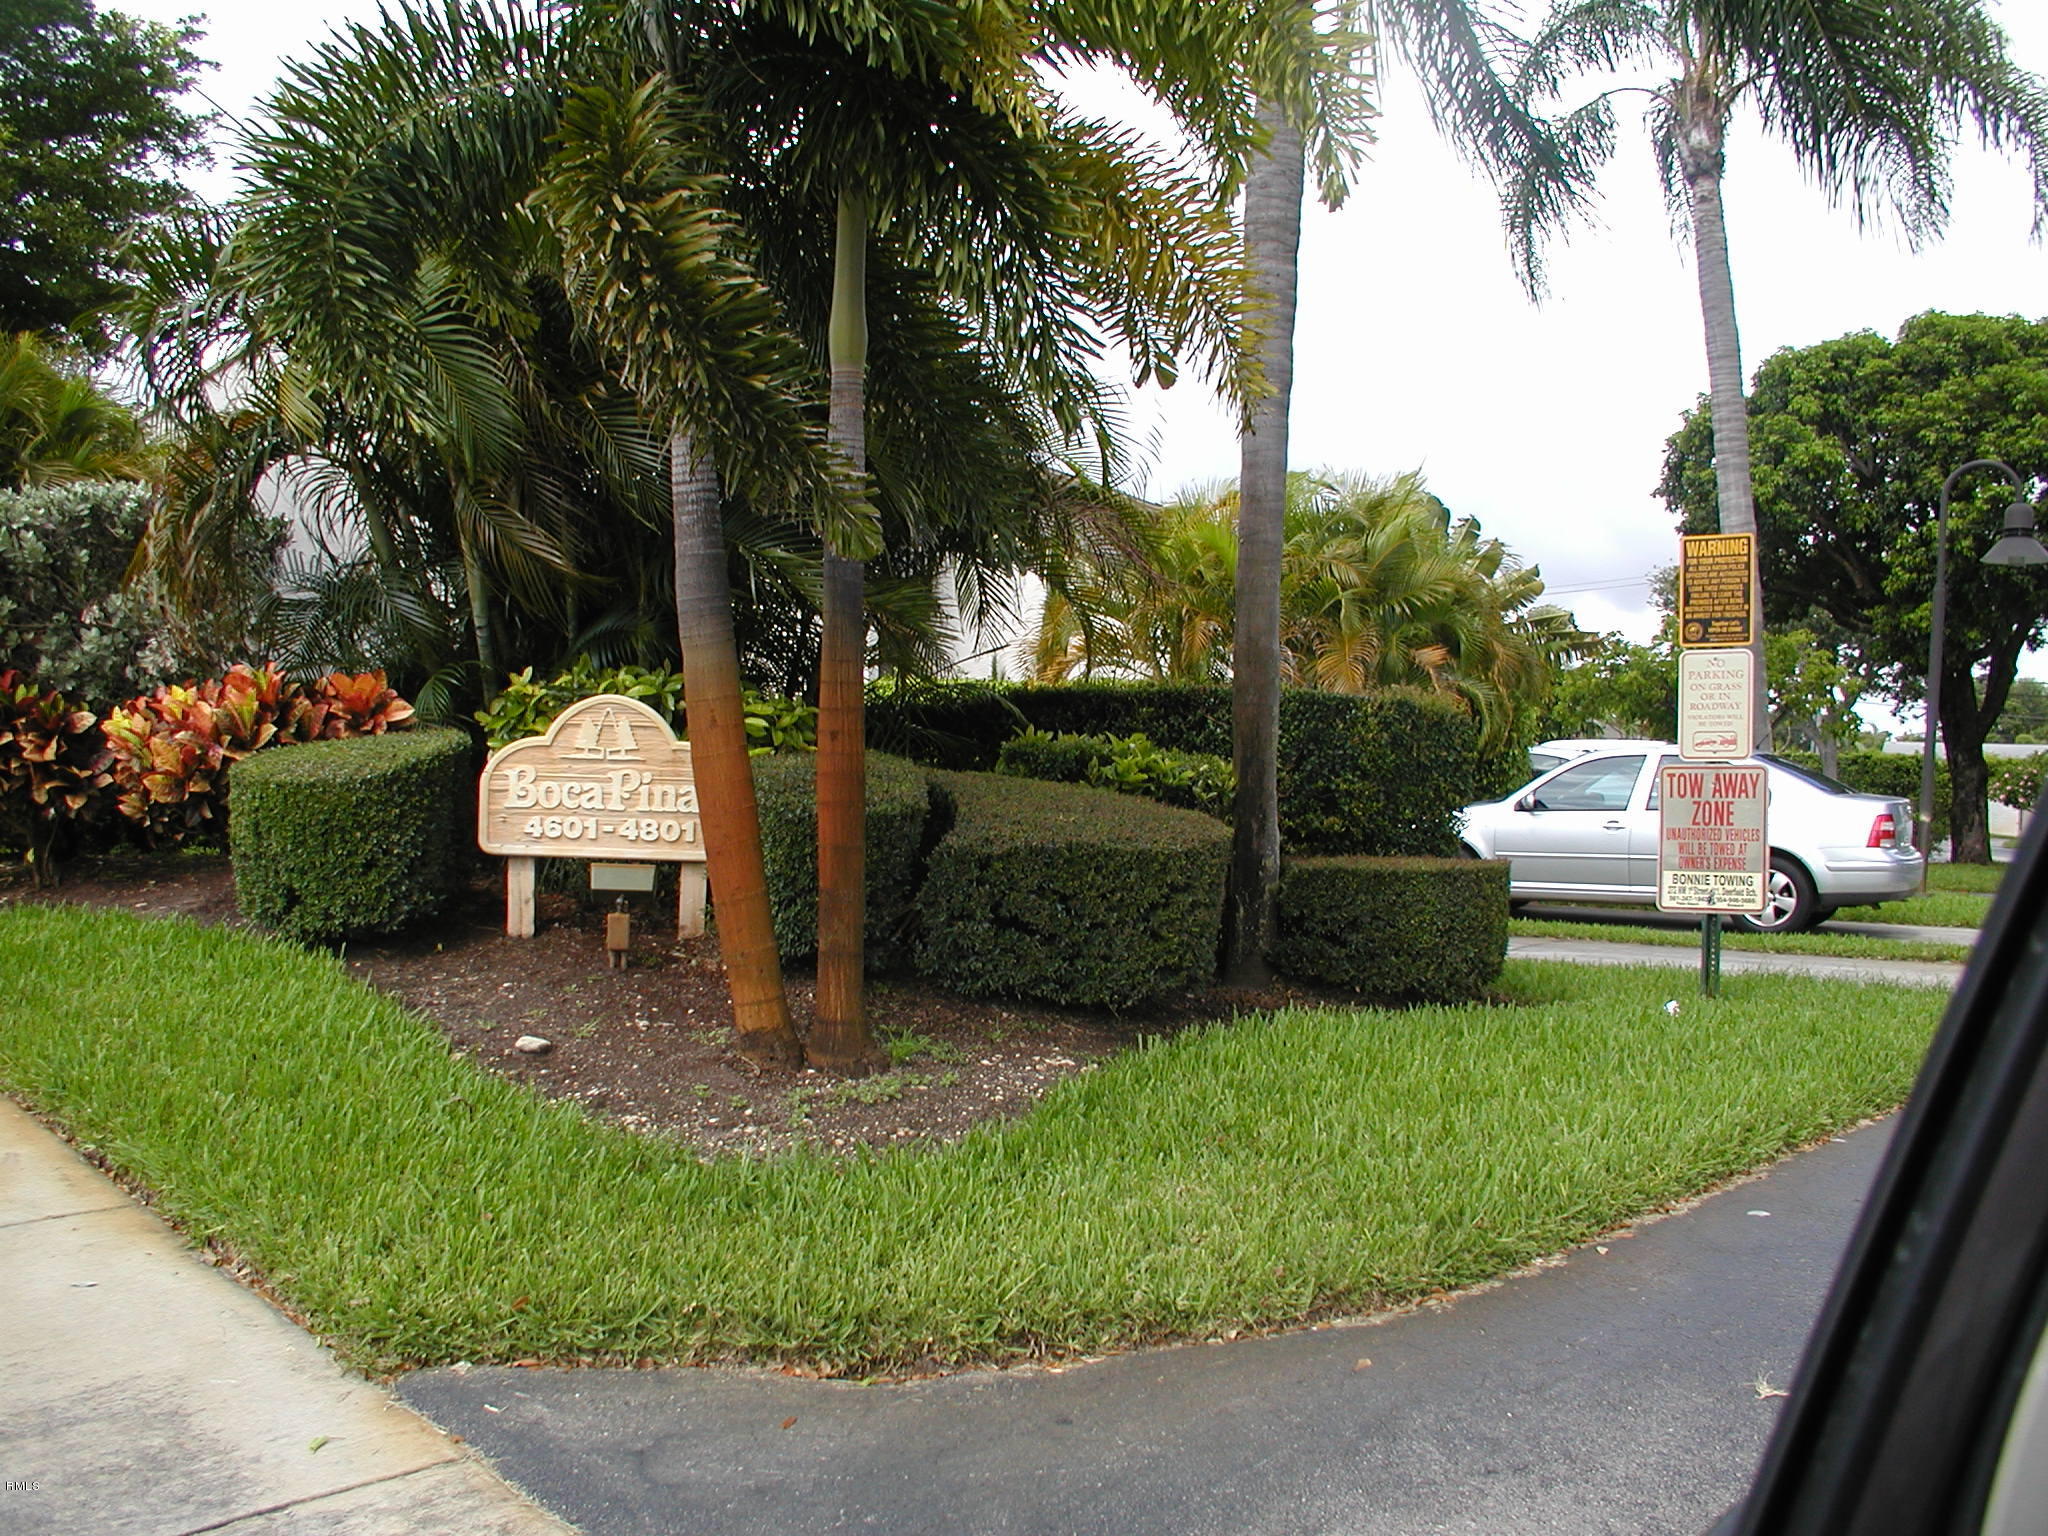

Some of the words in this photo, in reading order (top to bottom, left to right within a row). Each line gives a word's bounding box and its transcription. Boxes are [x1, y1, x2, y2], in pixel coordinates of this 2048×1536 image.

[1686, 539, 1748, 557] WARNING
[1706, 658, 1726, 668] NO
[1688, 670, 1744, 680] PARKING
[1689, 683, 1706, 691] ON
[1709, 682, 1742, 690] GRASS
[1719, 692, 1731, 700] IN
[1690, 702, 1741, 710] ROADWAY
[504, 764, 604, 811] Boca
[1666, 773, 1704, 798] TOW
[1712, 773, 1760, 798] AWAY
[1692, 800, 1735, 826] ZONE
[524, 815, 696, 843] 4601-4801
[1666, 828, 1721, 841] UNAUTHORIZED
[1726, 829, 1760, 842] VEHICLES
[1678, 842, 1695, 855] WILL
[1698, 842, 1707, 855] BE
[1710, 842, 1735, 856] TOWED
[1738, 843, 1748, 855] AT
[1679, 857, 1711, 869] OWNER'S
[1714, 857, 1746, 870] EXPENSE
[1672, 874, 1711, 886] BONNIE
[1713, 875, 1753, 887] TOWING
